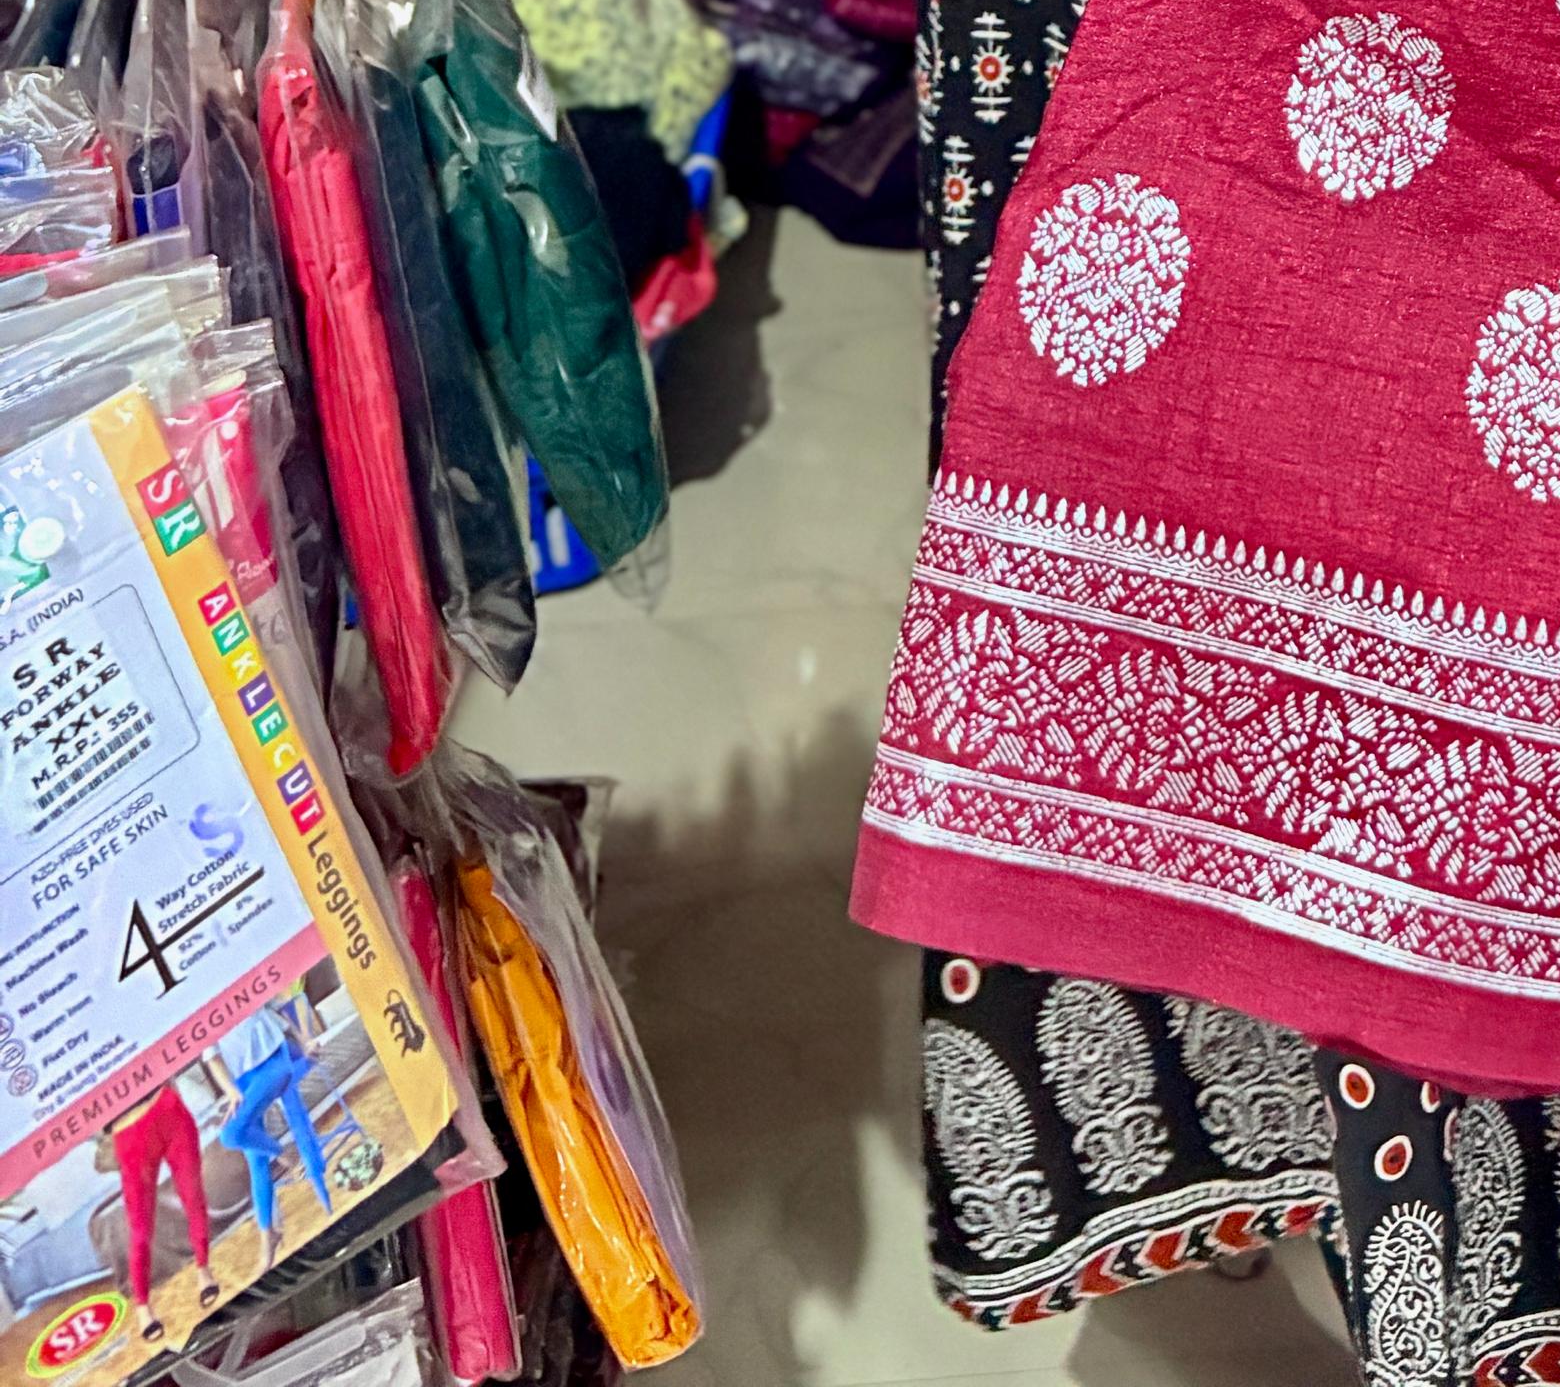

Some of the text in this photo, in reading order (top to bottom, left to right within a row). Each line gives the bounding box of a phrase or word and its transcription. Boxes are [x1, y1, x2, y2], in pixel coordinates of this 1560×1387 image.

[147, 469, 200, 551] SR
[26, 588, 84, 631] (INDIA)
[45, 636, 76, 666] R
[0, 641, 105, 730] FORWAY
[13, 662, 122, 754] ANKLE
[107, 701, 140, 732] 355
[46, 704, 112, 754] XXL
[32, 804, 169, 910] FOR SAFE SKIN
[155, 849, 235, 910] Way Cotton
[158, 860, 251, 934] Stretch Fabric
[307, 831, 377, 971] Leggings
[5, 951, 56, 991] Machine
[56, 928, 89, 954] Wash
[179, 940, 216, 972] Cotton
[33, 965, 283, 1159] PREMIUM LEGGINGS
[38, 1035, 125, 1102] MADE IN INDIA
[65, 1030, 89, 1052] Dry
[49, 1308, 106, 1360] SR
